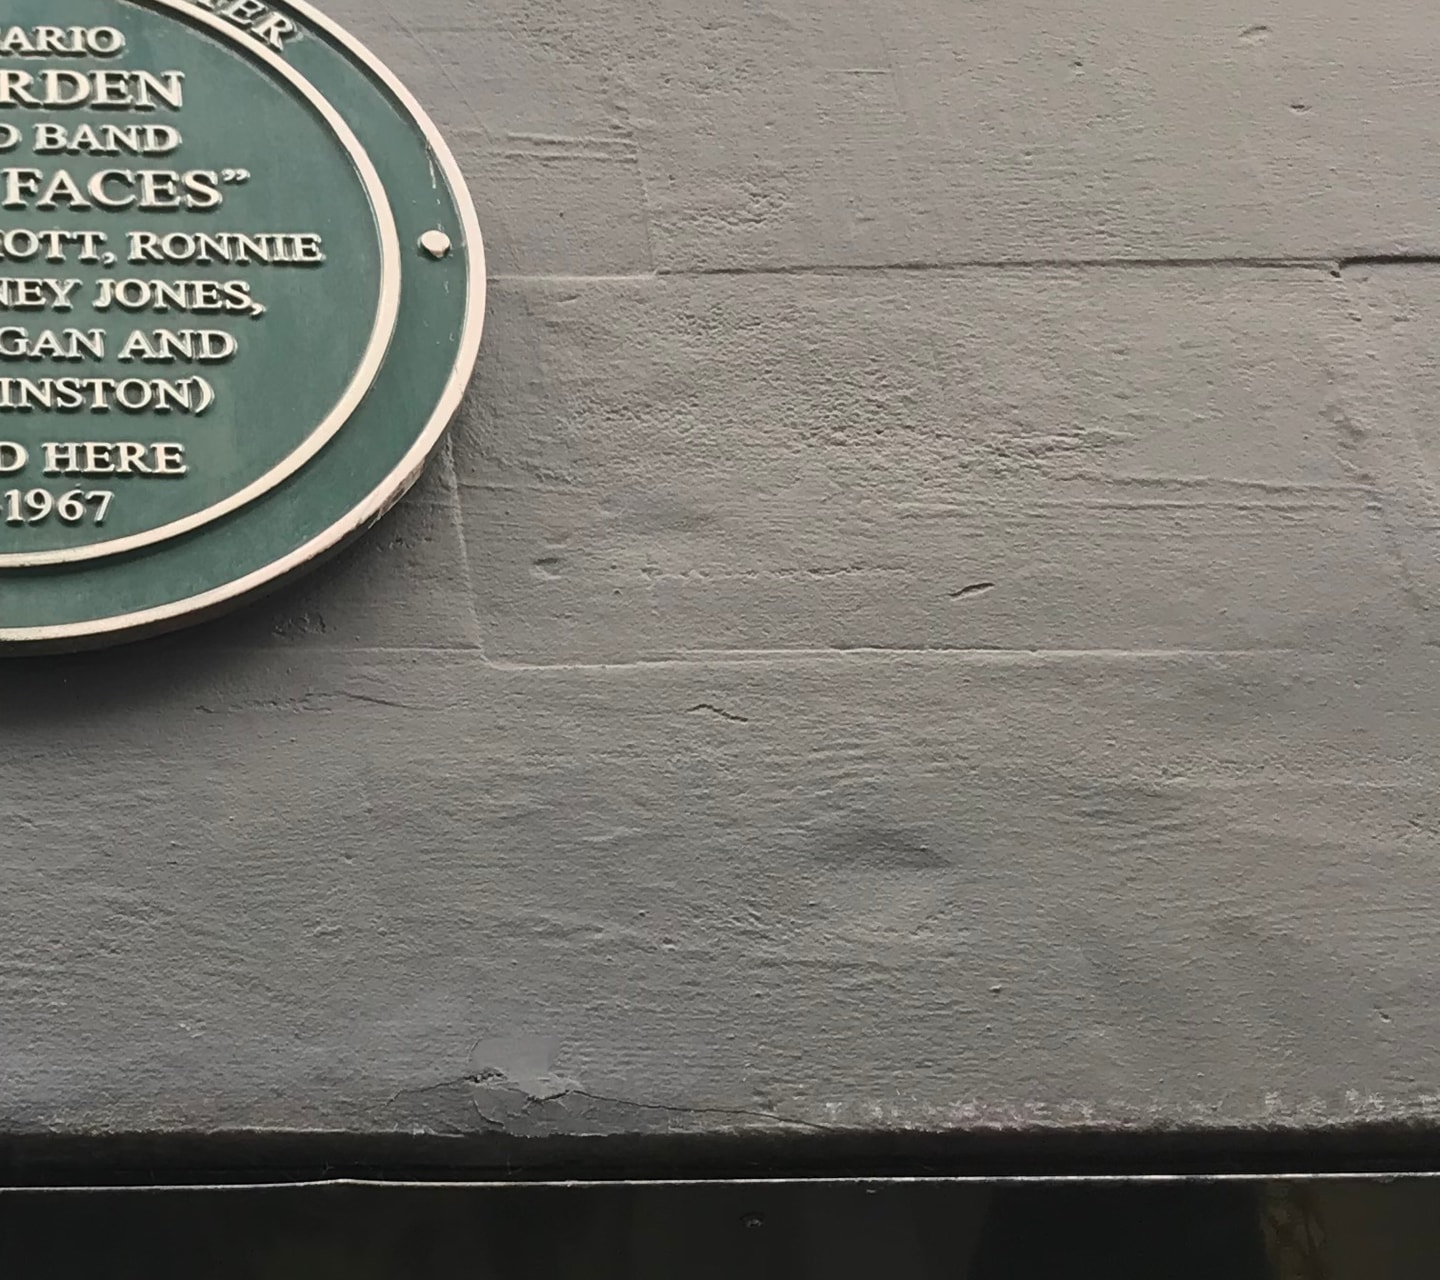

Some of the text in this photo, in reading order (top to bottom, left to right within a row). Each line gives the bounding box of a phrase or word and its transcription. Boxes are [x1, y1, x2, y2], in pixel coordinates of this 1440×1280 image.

[33, 124, 183, 154] BAND
[1, 168, 250, 212] FACES”
[127, 231, 326, 265] RONNIE
[93, 279, 266, 318] JONES,
[118, 328, 238, 364] AND
[42, 442, 188, 476] HERE
